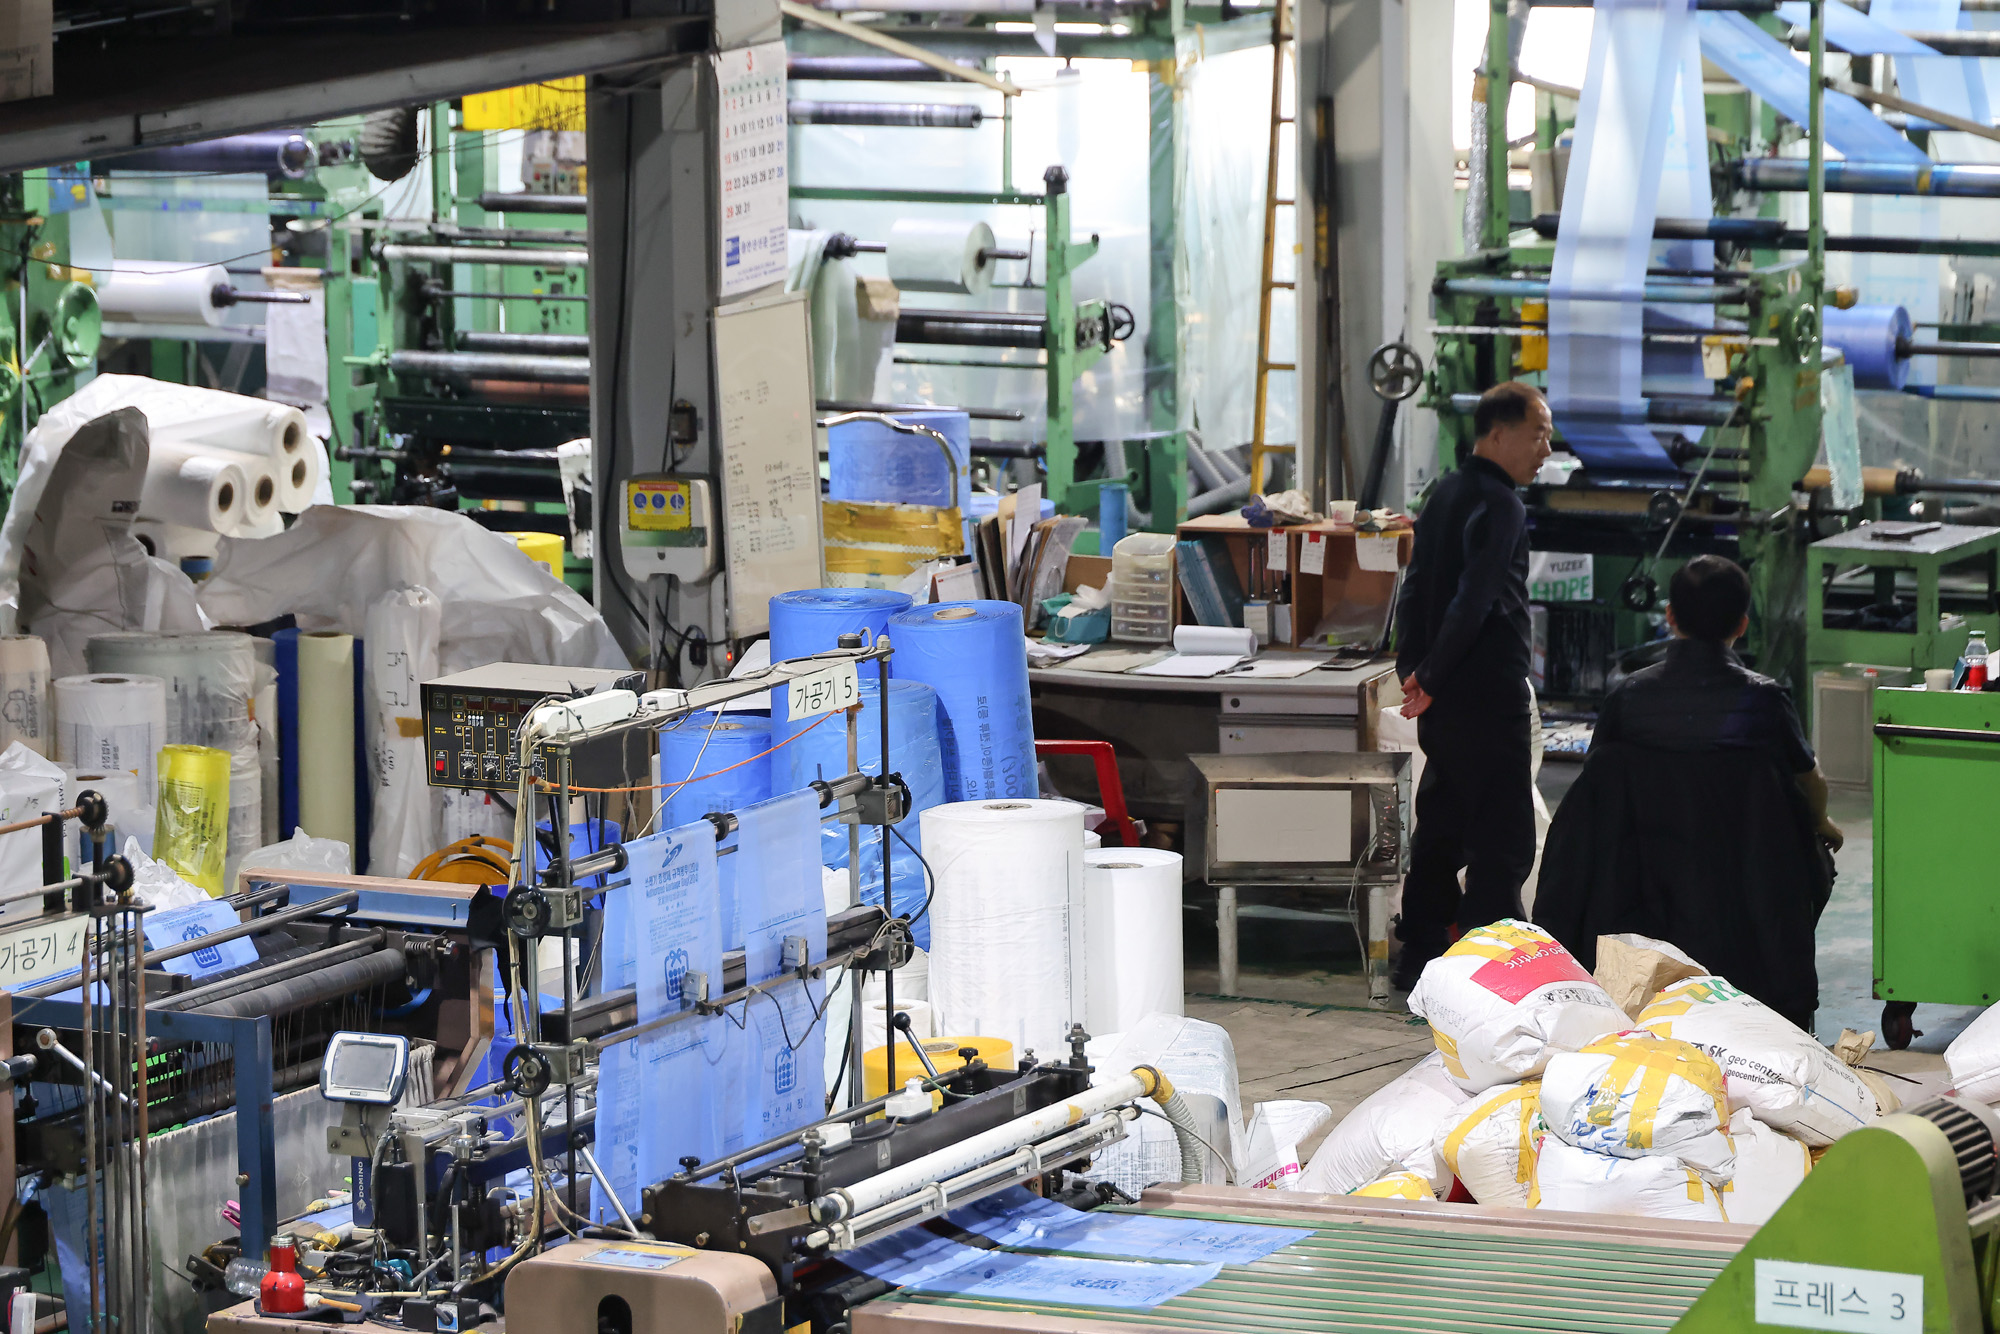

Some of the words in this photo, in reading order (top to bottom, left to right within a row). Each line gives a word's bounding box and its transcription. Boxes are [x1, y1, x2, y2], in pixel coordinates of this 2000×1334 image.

[746, 51, 753, 71] 3
[796, 676, 836, 713] 가공기
[844, 676, 852, 699] 5
[0, 932, 57, 975] 가공기
[67, 931, 78, 955] 4
[1504, 948, 1550, 969] centric
[1708, 1045, 1728, 1058] SK
[1728, 1053, 1747, 1066] geo
[1748, 1060, 1786, 1082] centric
[357, 1161, 365, 1198] DOMINO
[1771, 1279, 1870, 1317] 프레스
[1889, 1292, 1906, 1321] 3
